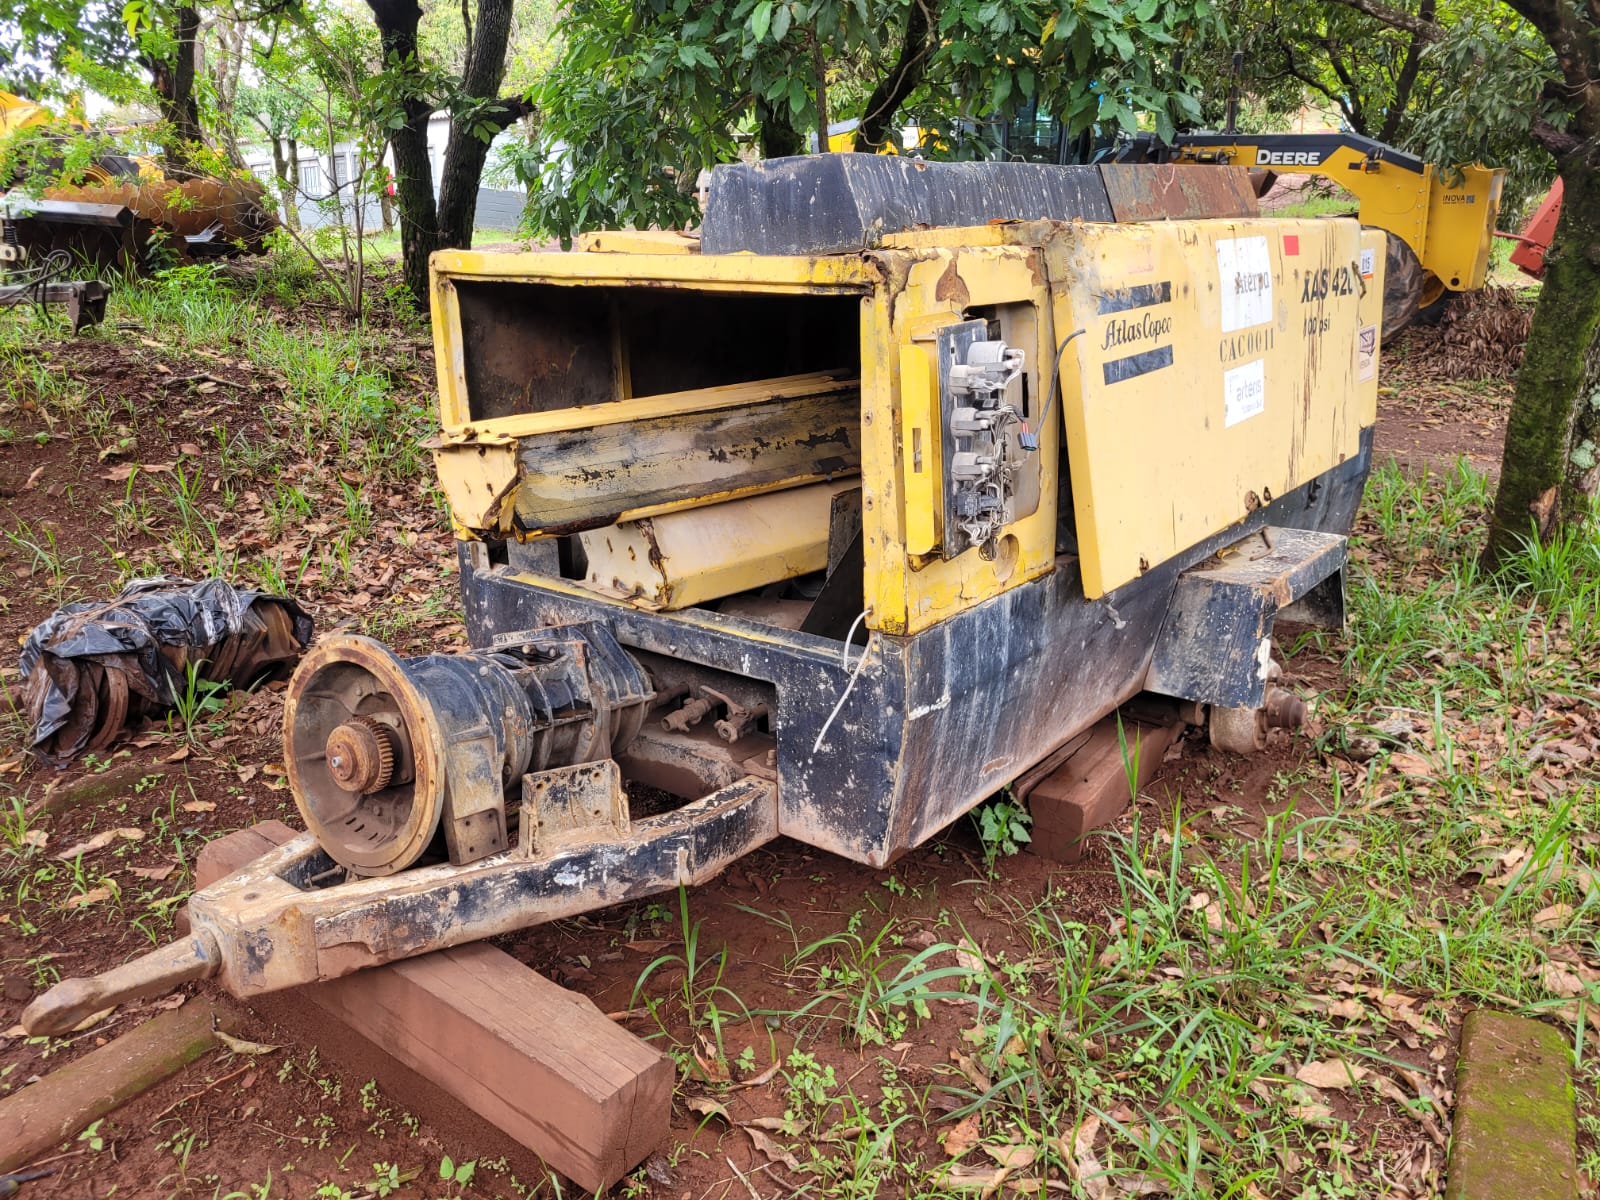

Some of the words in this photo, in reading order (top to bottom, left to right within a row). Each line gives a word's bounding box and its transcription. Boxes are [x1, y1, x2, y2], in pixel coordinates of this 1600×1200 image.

[1256, 149, 1320, 165] DEERE
[1442, 194, 1465, 202] INOVA
[1301, 268, 1329, 303] XAS
[1101, 319, 1142, 351] Atlas
[1319, 312, 1331, 337] psi
